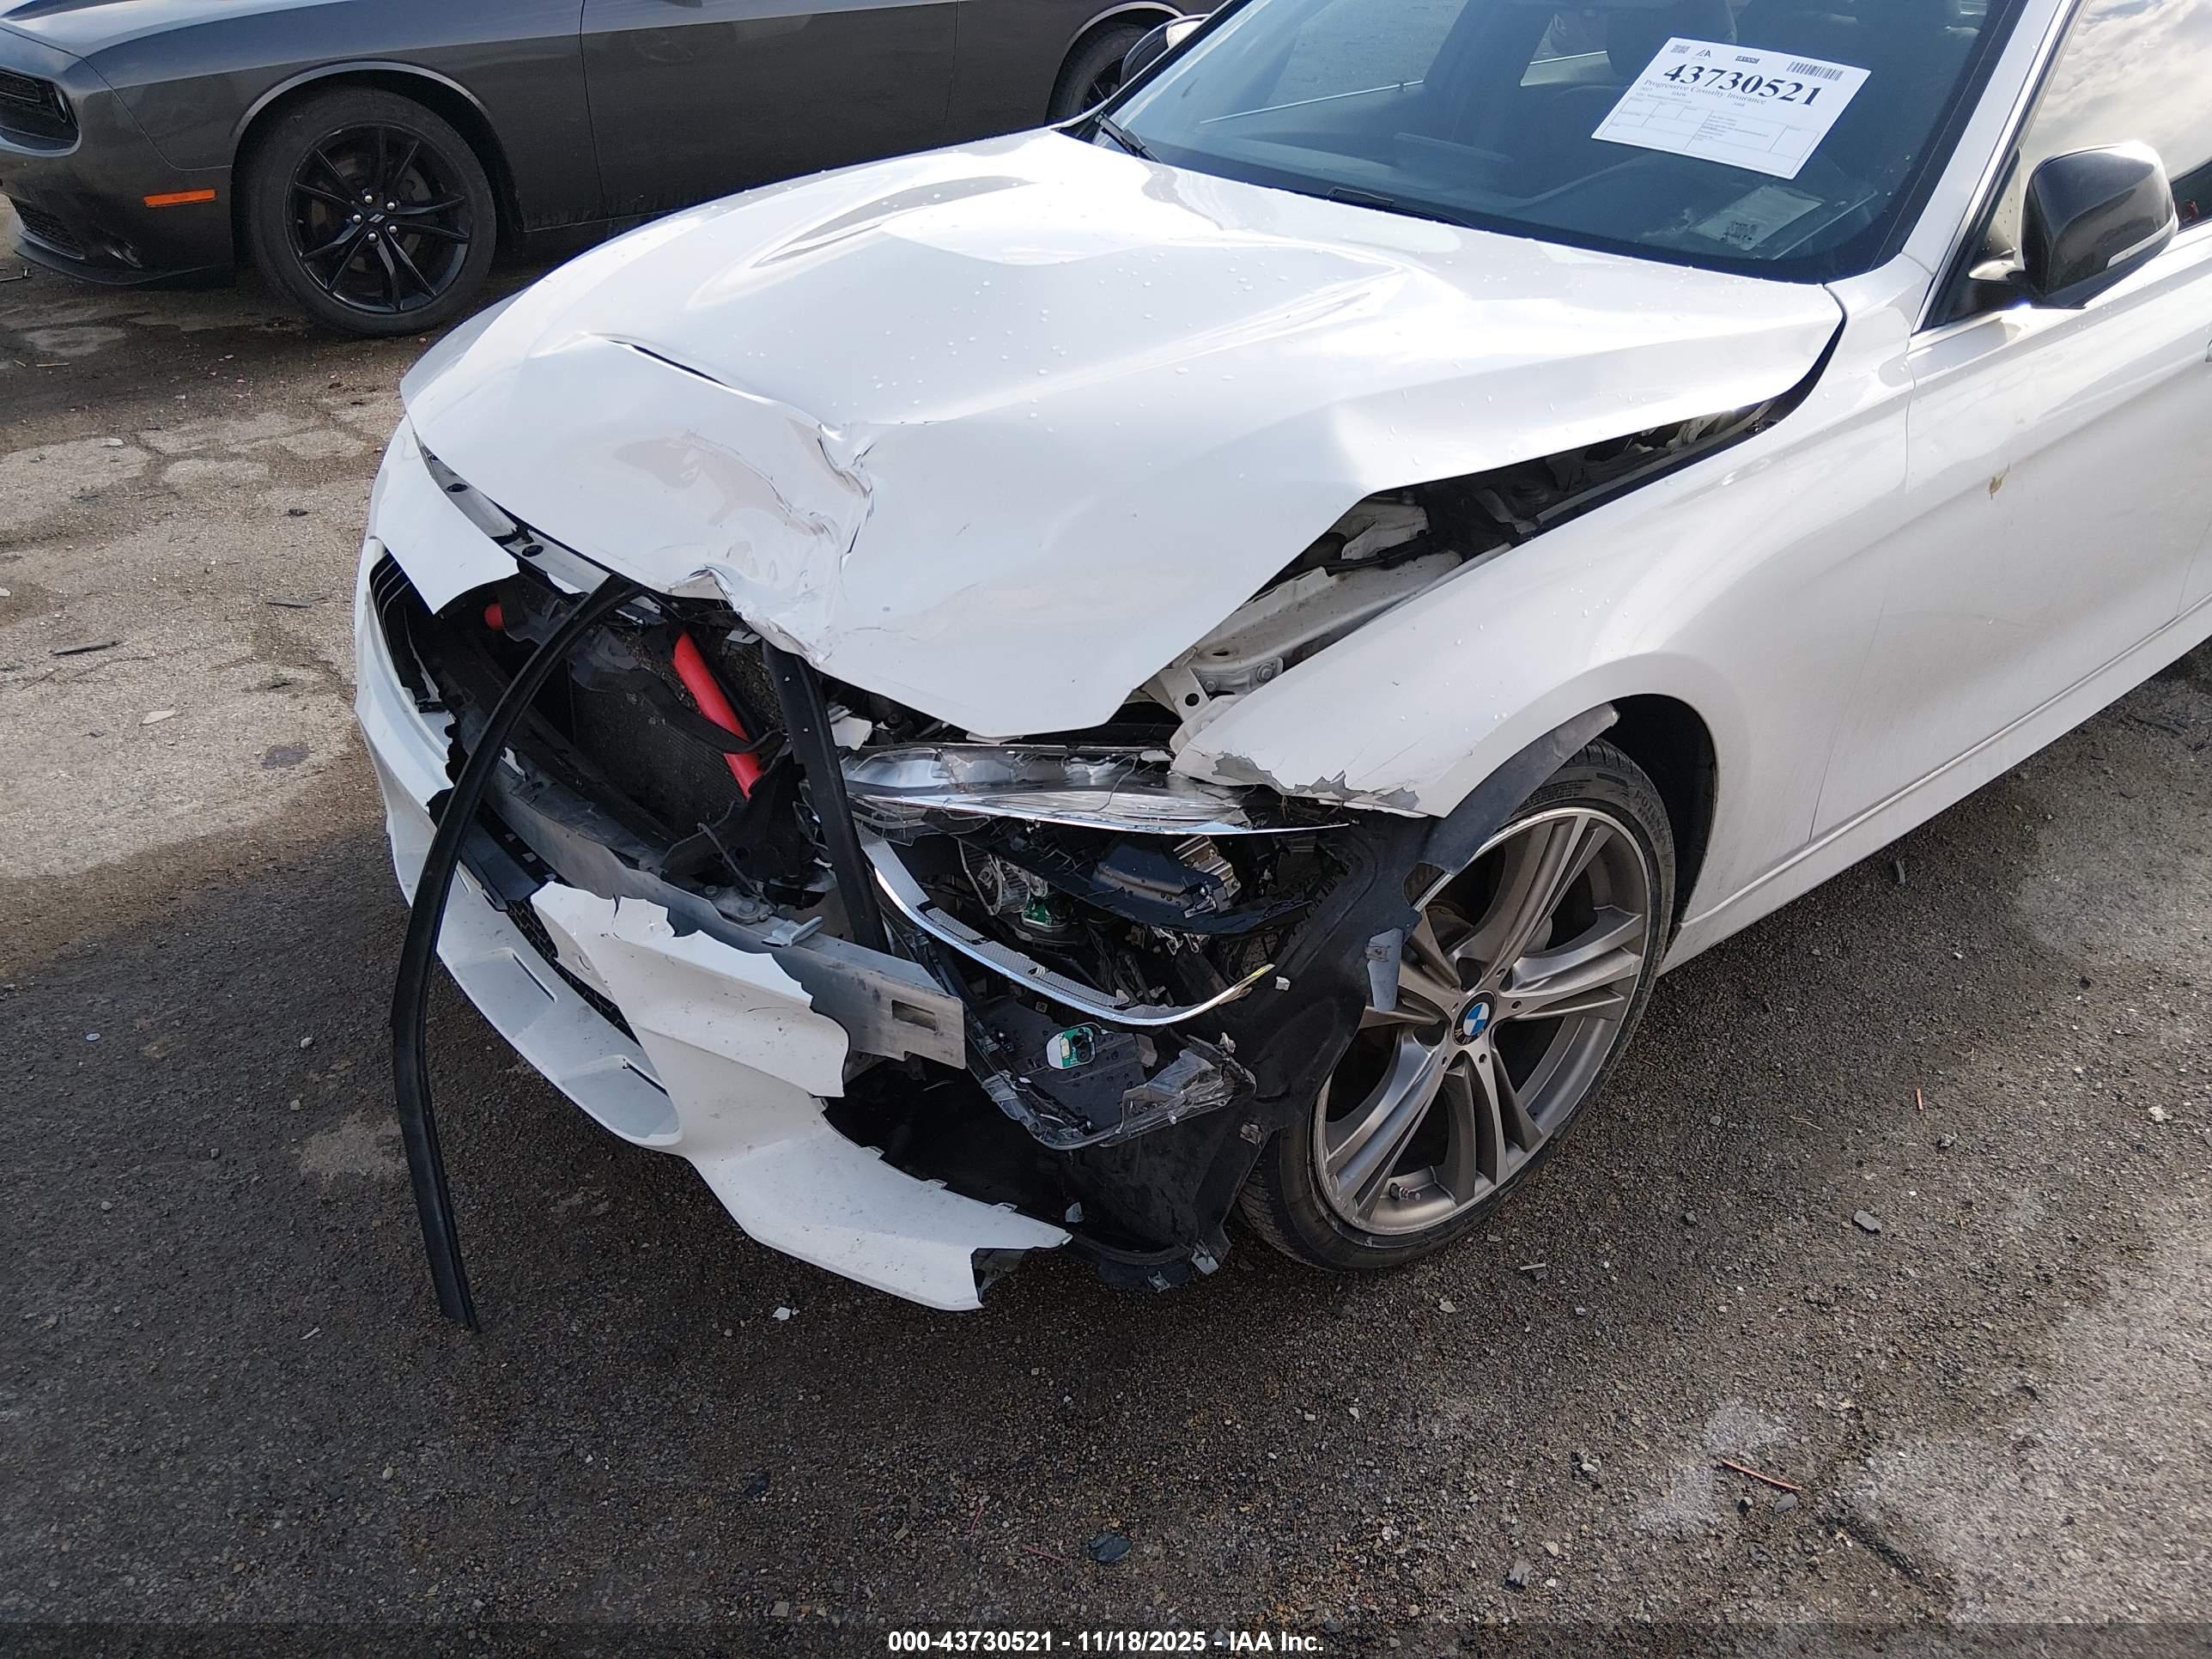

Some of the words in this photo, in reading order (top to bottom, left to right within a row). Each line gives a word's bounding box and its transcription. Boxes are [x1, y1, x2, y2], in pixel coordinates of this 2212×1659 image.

[1644, 79, 1689, 94] Progressive
[1690, 86, 1726, 99] Casualty
[1727, 92, 1766, 106] Insurance
[1663, 64, 1821, 106] 43730521
